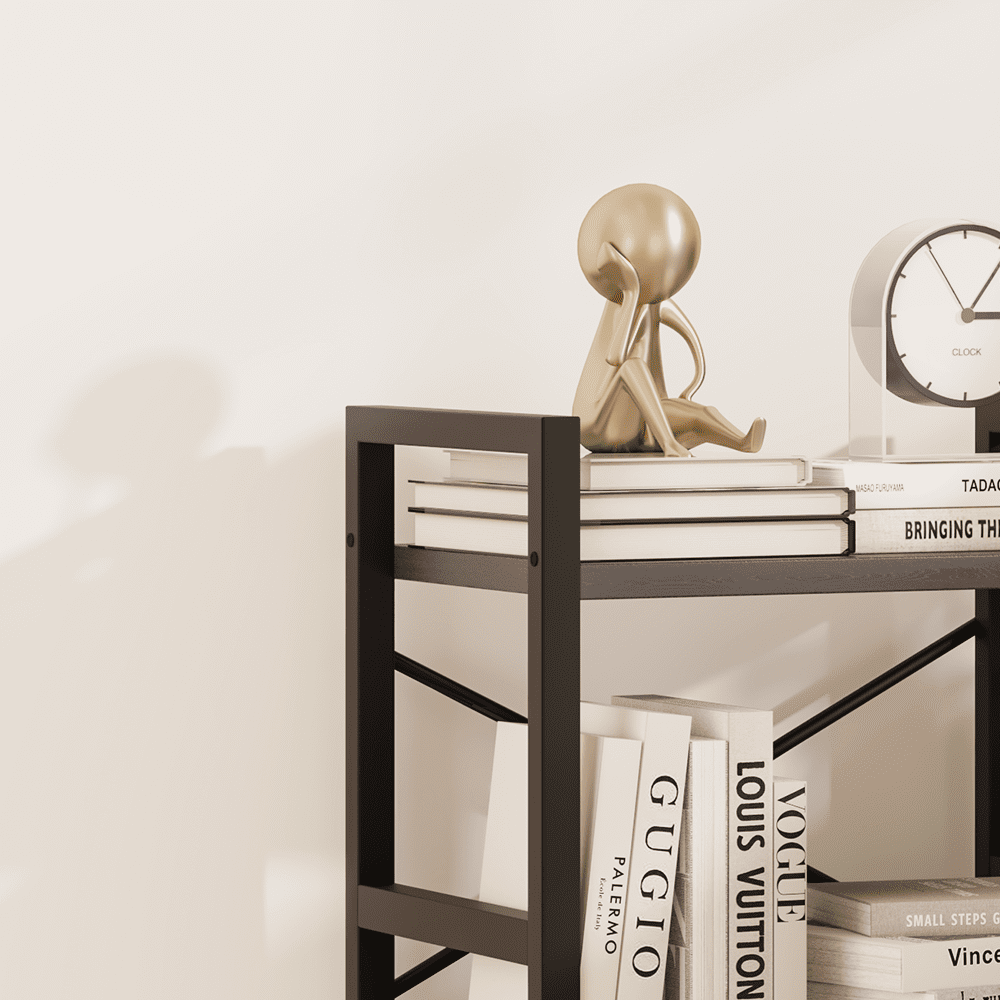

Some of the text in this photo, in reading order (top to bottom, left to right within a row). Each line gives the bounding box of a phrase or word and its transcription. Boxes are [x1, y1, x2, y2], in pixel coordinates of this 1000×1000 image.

[952, 348, 982, 356] CLOCK
[905, 520, 973, 540] BRINGING
[776, 786, 807, 924] VOGUE
[632, 775, 679, 978] GUGIO
[736, 761, 766, 1000] LOUIS VUITTON
[596, 901, 603, 912] de
[604, 855, 627, 955] PALERMO
[593, 912, 602, 932] Italy
[906, 914, 946, 928] SMALL
[951, 912, 987, 926] STEPS
